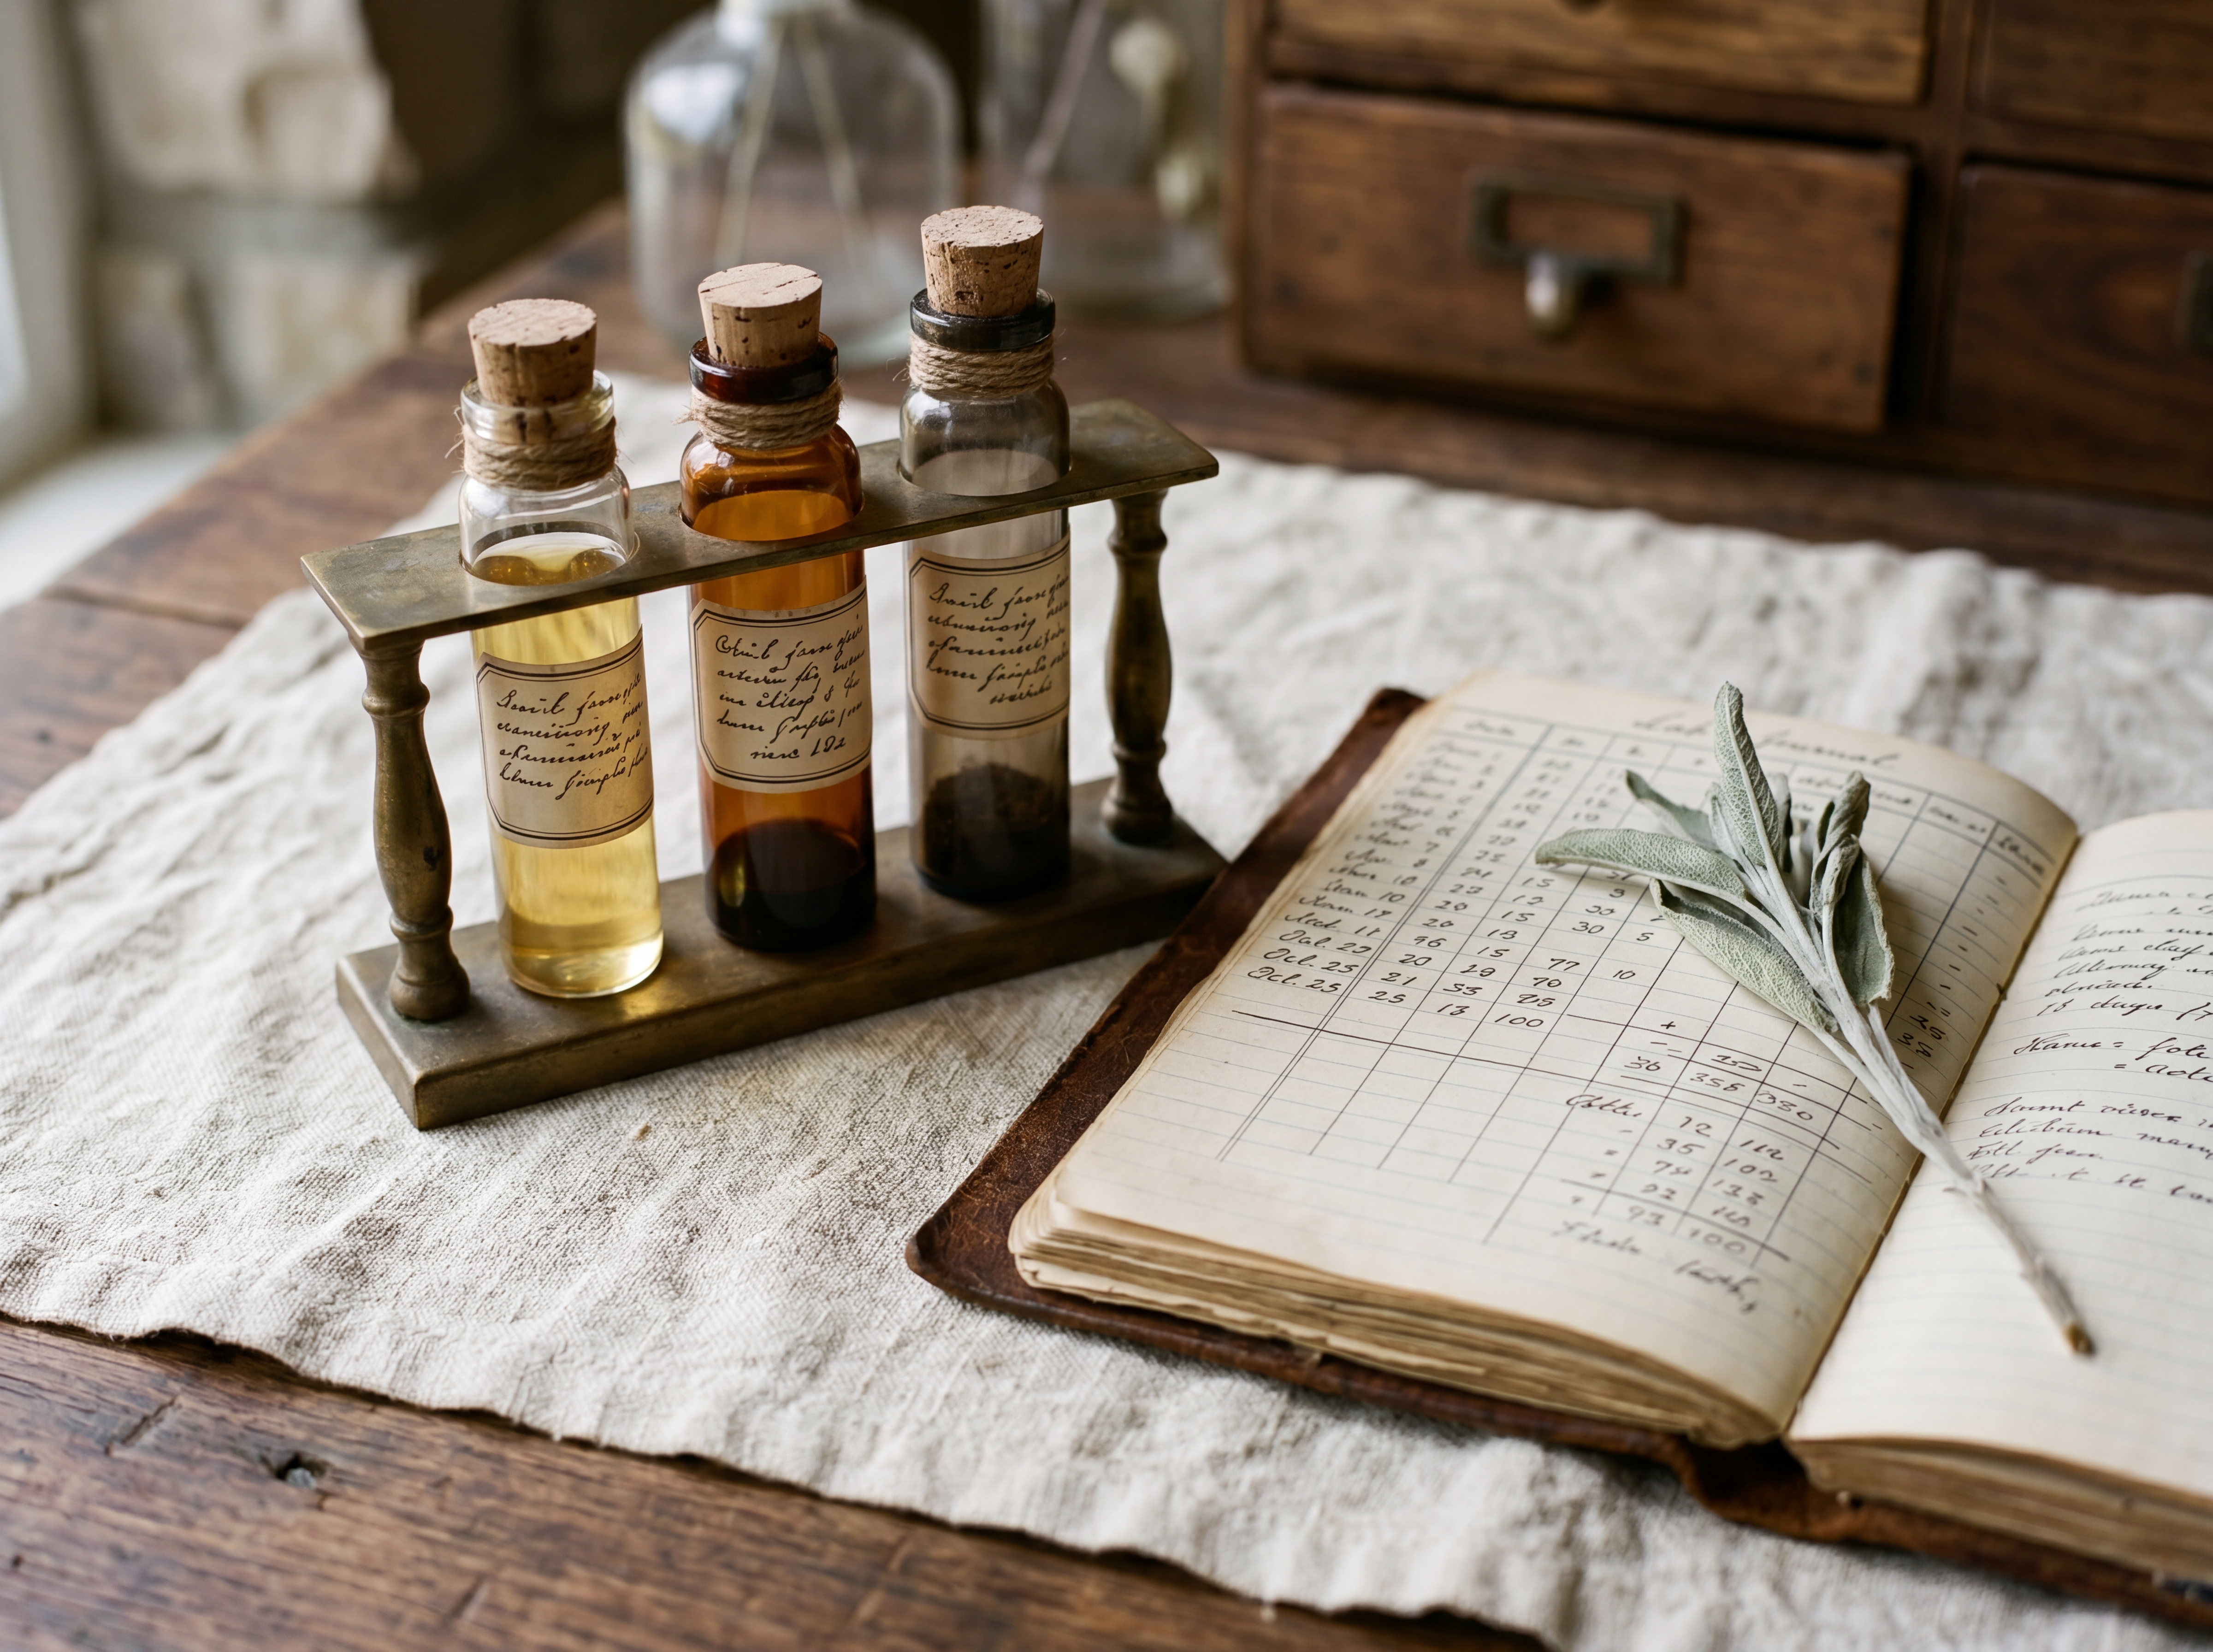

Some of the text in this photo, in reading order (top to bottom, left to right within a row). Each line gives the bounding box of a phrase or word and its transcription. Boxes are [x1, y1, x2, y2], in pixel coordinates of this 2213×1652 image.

[1501, 911, 1535, 922] 15
[1571, 921, 1605, 934] 30
[1320, 962, 1360, 974] 25
[1477, 946, 1510, 958] 15
[1612, 969, 1636, 980] 10
[1305, 979, 1342, 993] 25
[1367, 991, 1407, 1003] 25
[1494, 1013, 1544, 1027] 100
[1657, 1138, 1706, 1155] 35
